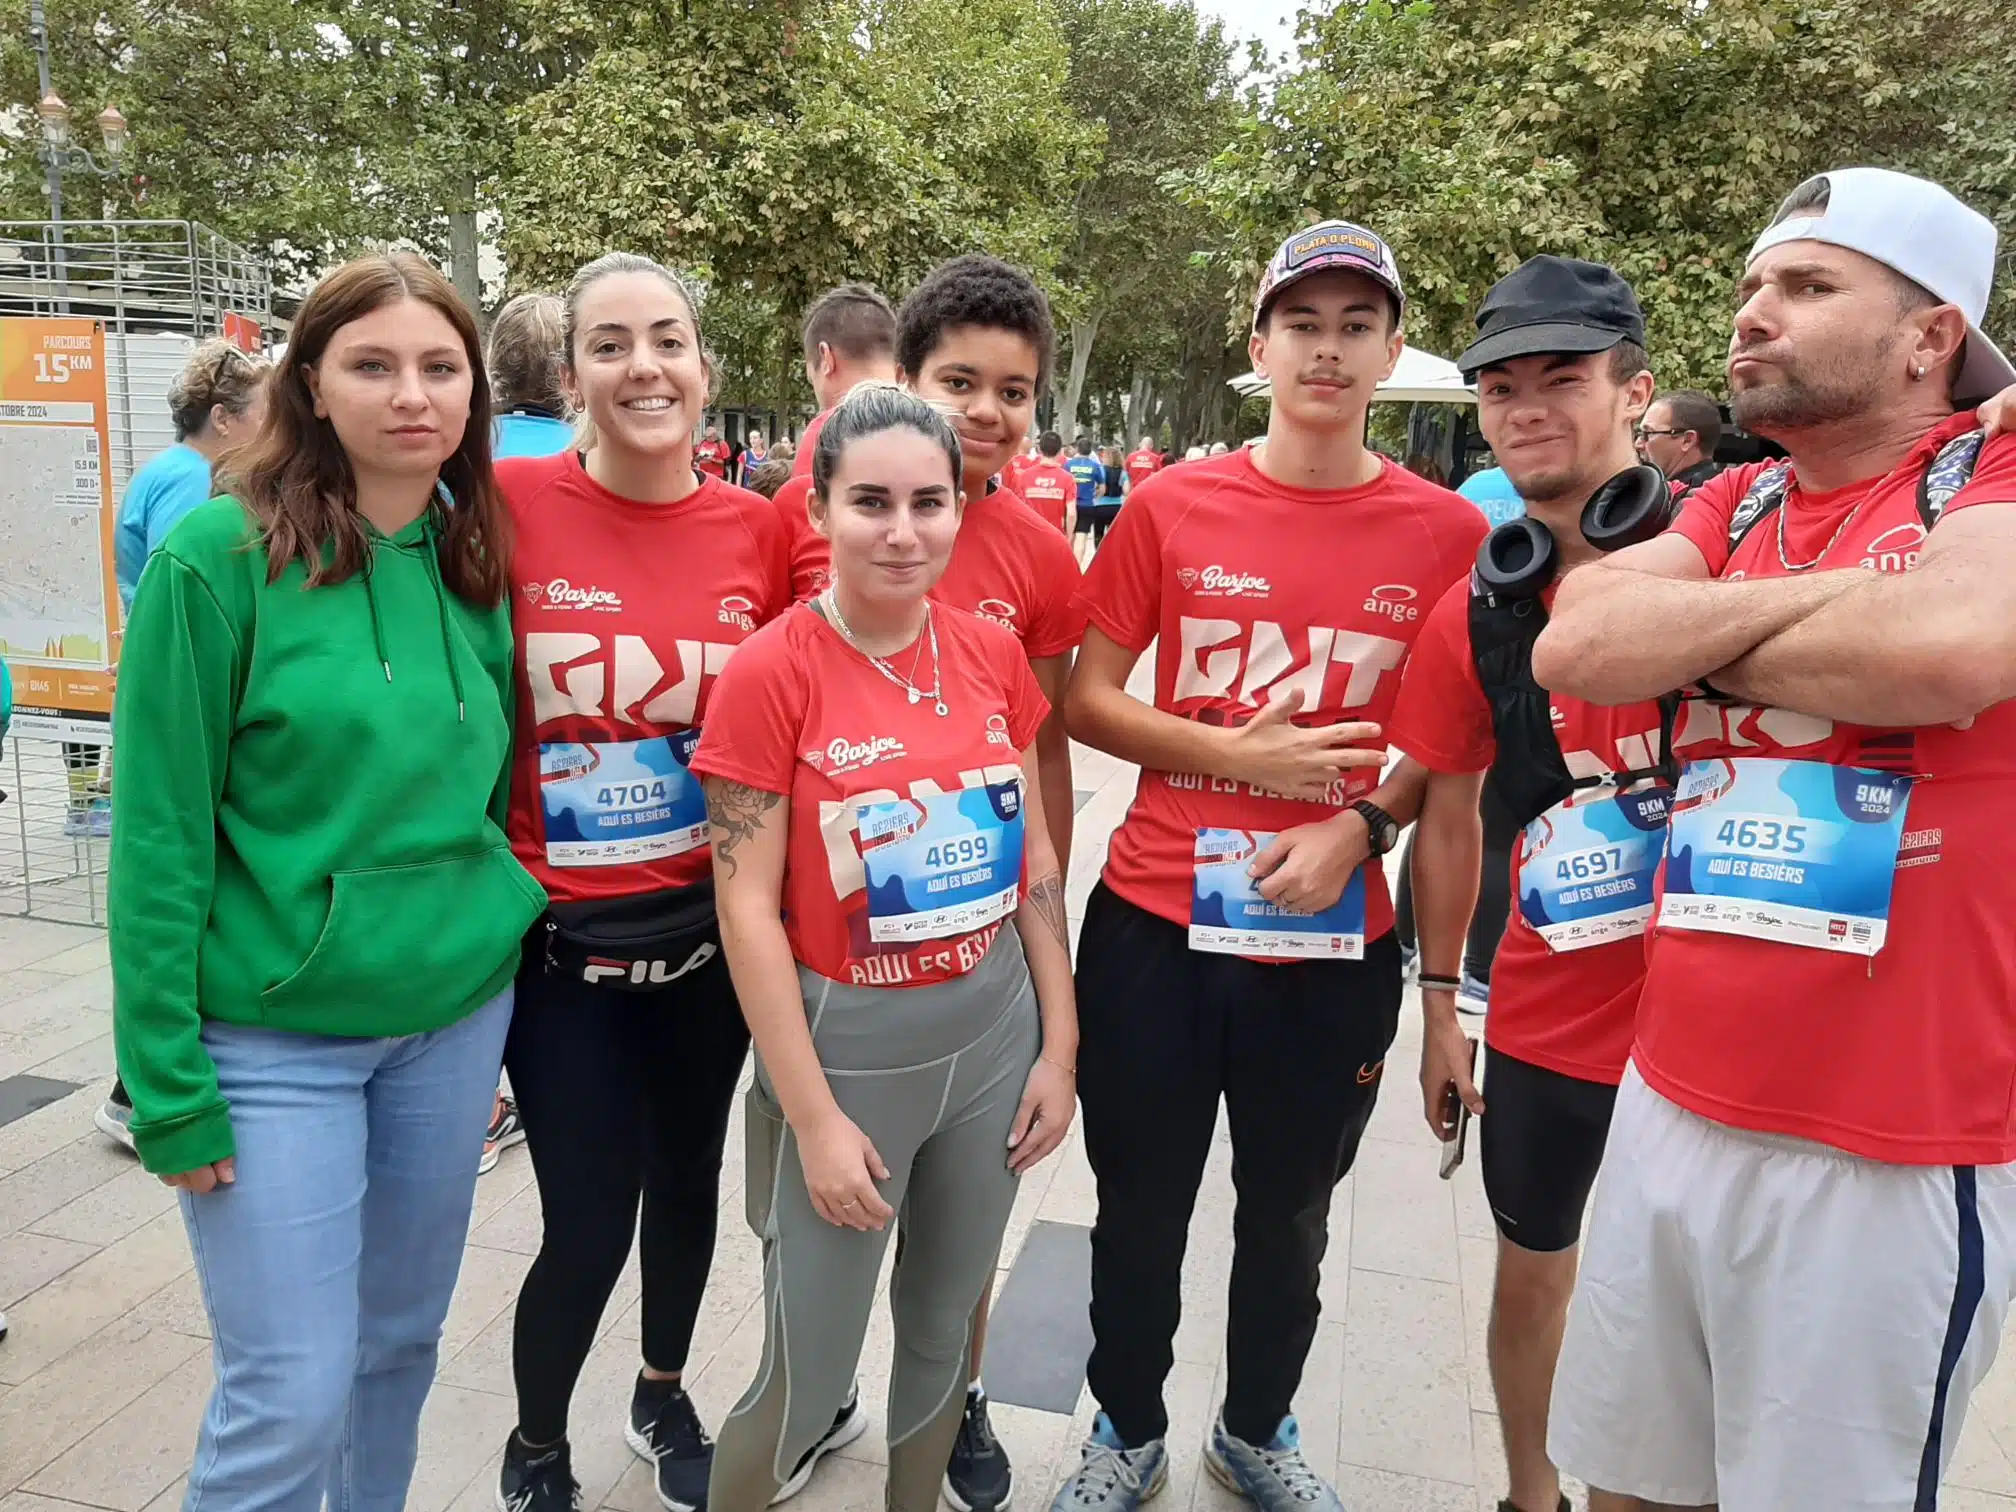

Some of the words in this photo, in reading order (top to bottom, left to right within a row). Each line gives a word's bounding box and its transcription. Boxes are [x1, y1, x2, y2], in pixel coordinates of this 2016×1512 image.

[1294, 236, 1326, 254] PLATA
[1329, 234, 1338, 245] O
[1339, 234, 1376, 252] PLOMO
[43, 335, 92, 349] PARCOURS
[0, 404, 25, 417] TOBRE
[27, 405, 48, 417] 2024
[1363, 598, 1418, 623] ange
[11, 705, 58, 716] BONNEZ-VOUS
[597, 781, 667, 807] 4704
[1646, 812, 1668, 822] 2024
[1860, 803, 1890, 815] 2024
[621, 813, 633, 825] ES
[1716, 818, 1807, 853] 4635
[925, 836, 989, 869] 4699
[1556, 847, 1622, 882] 4697
[1732, 860, 1748, 876] ES
[949, 874, 961, 888] ES
[1578, 885, 1594, 902] ES
[1266, 904, 1277, 916] ES
[583, 942, 717, 984] FILA
